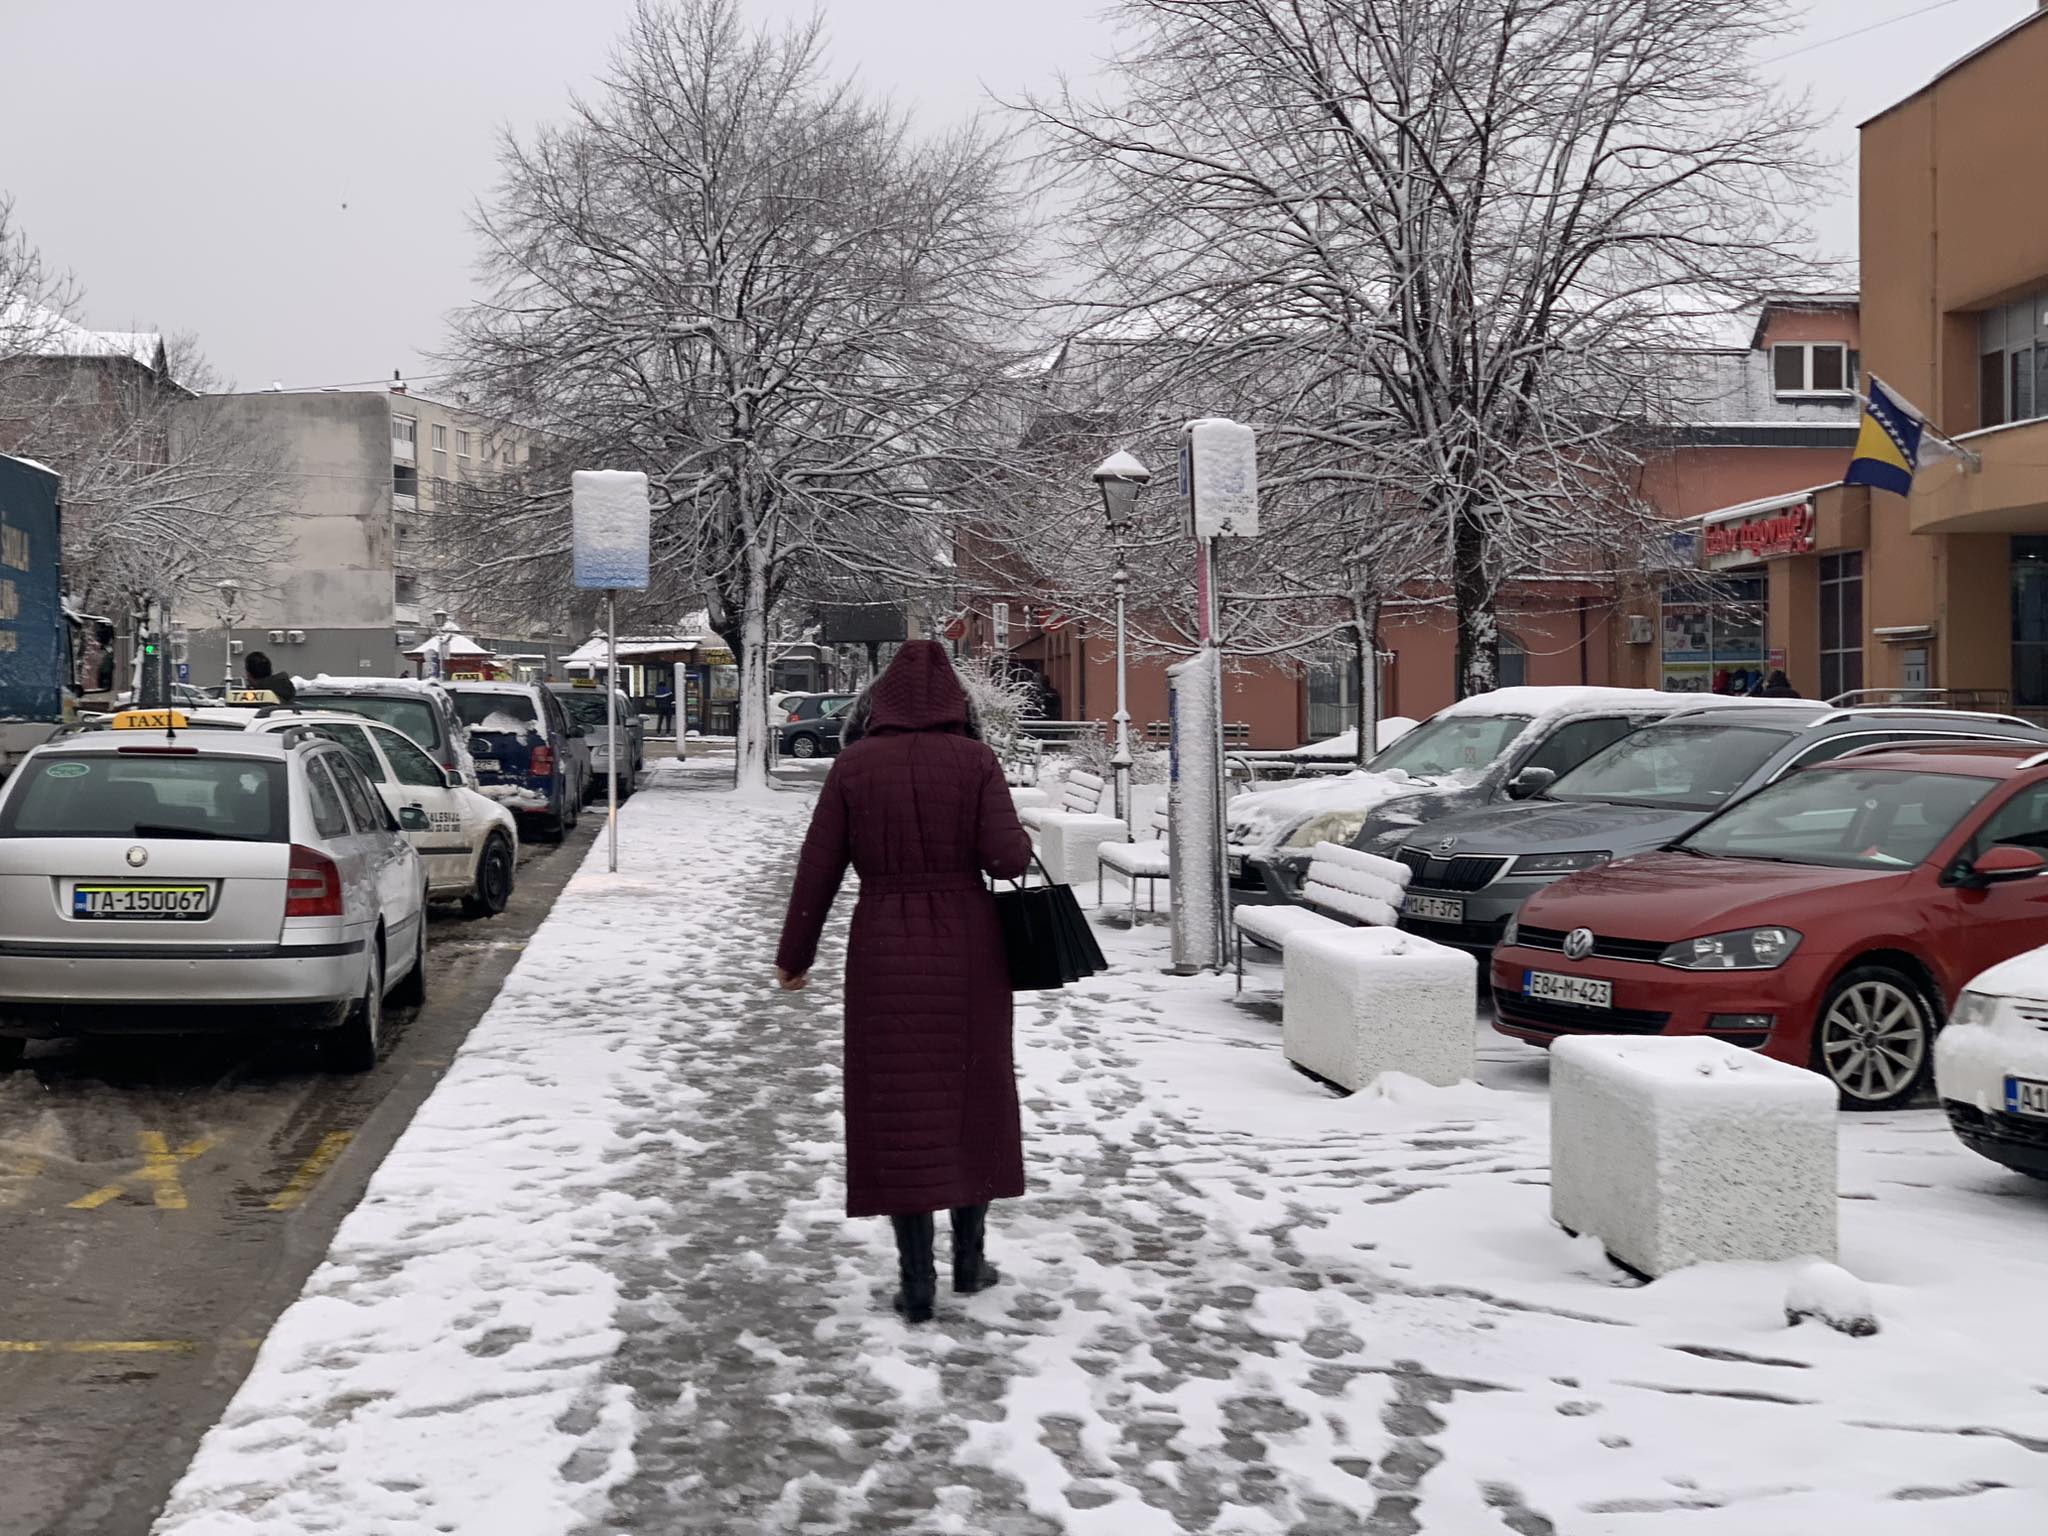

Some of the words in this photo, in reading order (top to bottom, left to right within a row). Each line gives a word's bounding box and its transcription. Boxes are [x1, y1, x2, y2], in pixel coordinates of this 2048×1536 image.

[232, 692, 265, 702] TAXI
[126, 714, 174, 728] TAXI
[90, 891, 206, 911] TA-150067
[1532, 974, 1608, 1004] E84-M-423
[2021, 1085, 2048, 1113] A1
